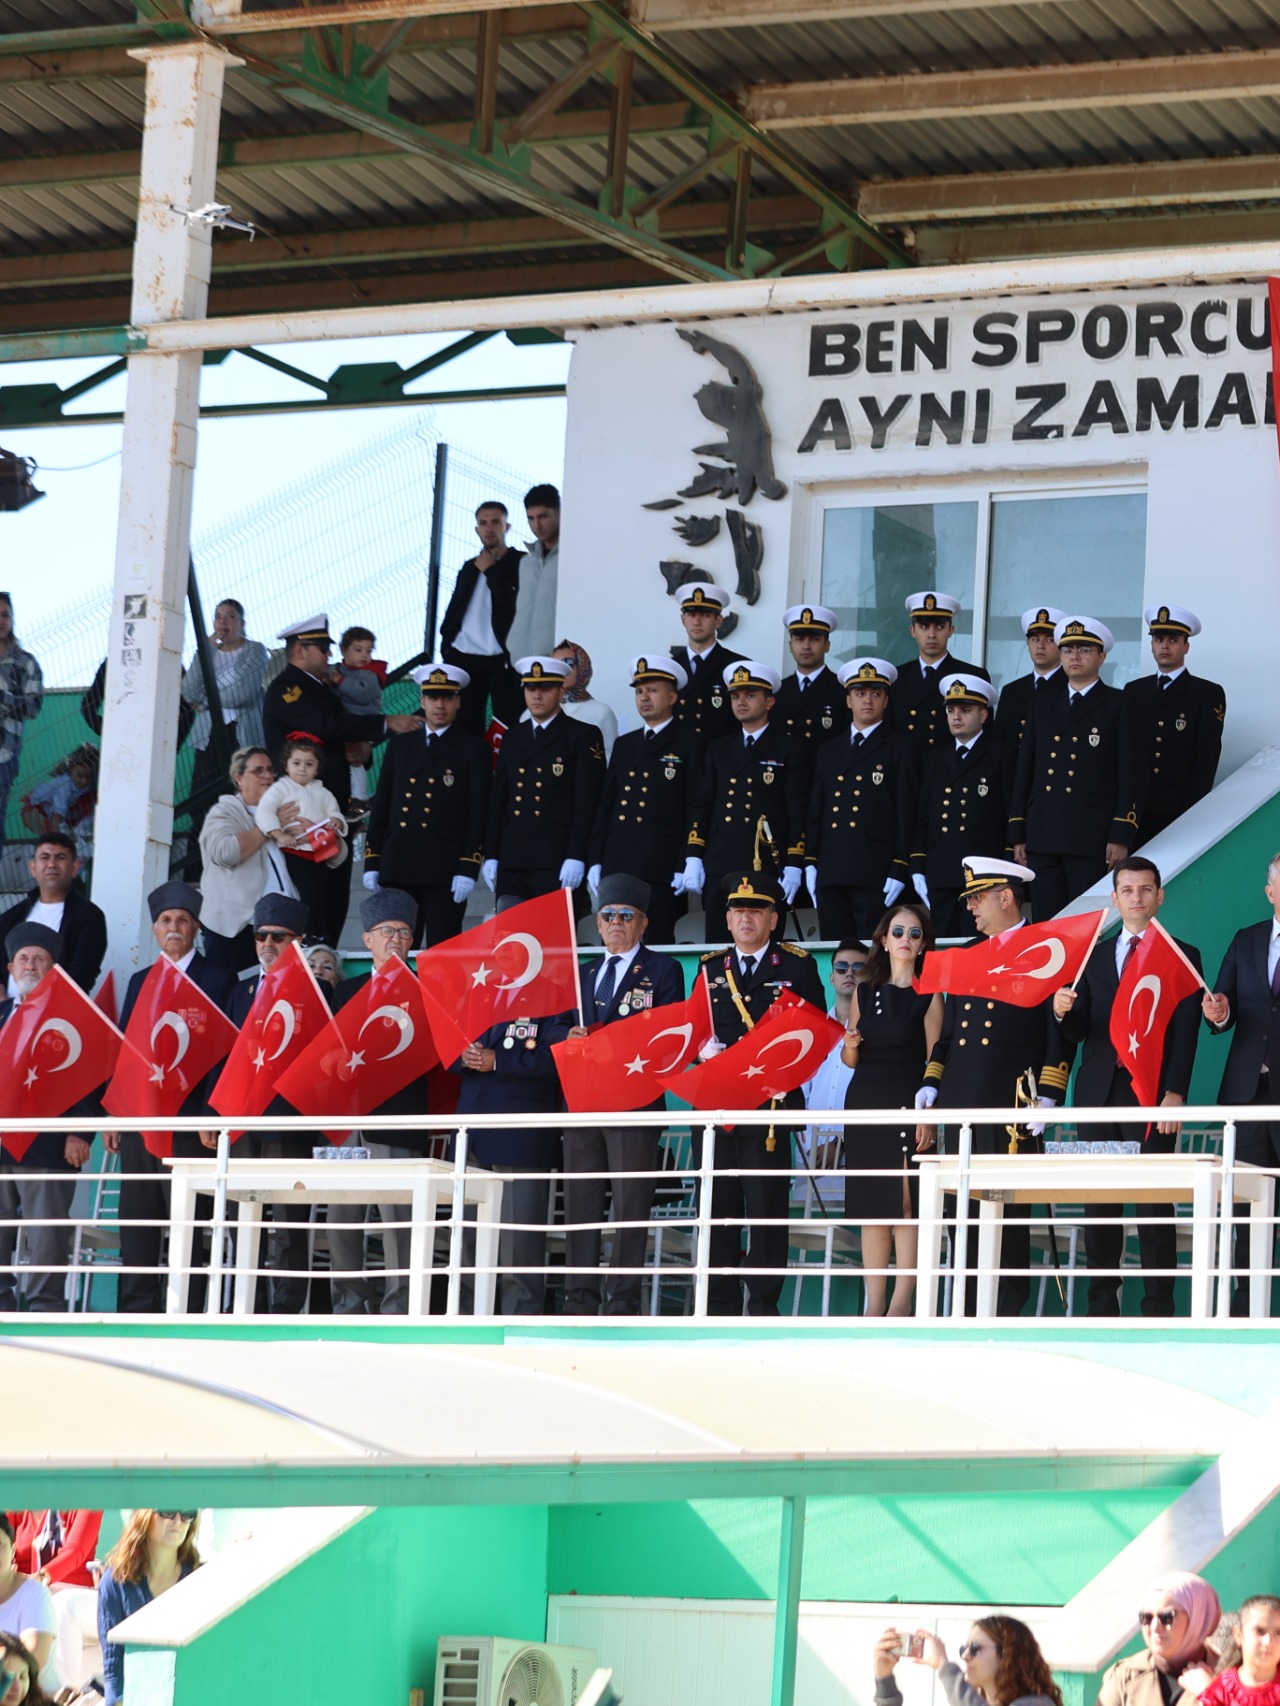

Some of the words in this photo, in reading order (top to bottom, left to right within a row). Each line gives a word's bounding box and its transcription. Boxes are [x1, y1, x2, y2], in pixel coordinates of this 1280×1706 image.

[808, 316, 950, 377] BEN
[971, 297, 1273, 367] SPORCU
[796, 388, 992, 454] AYNI
